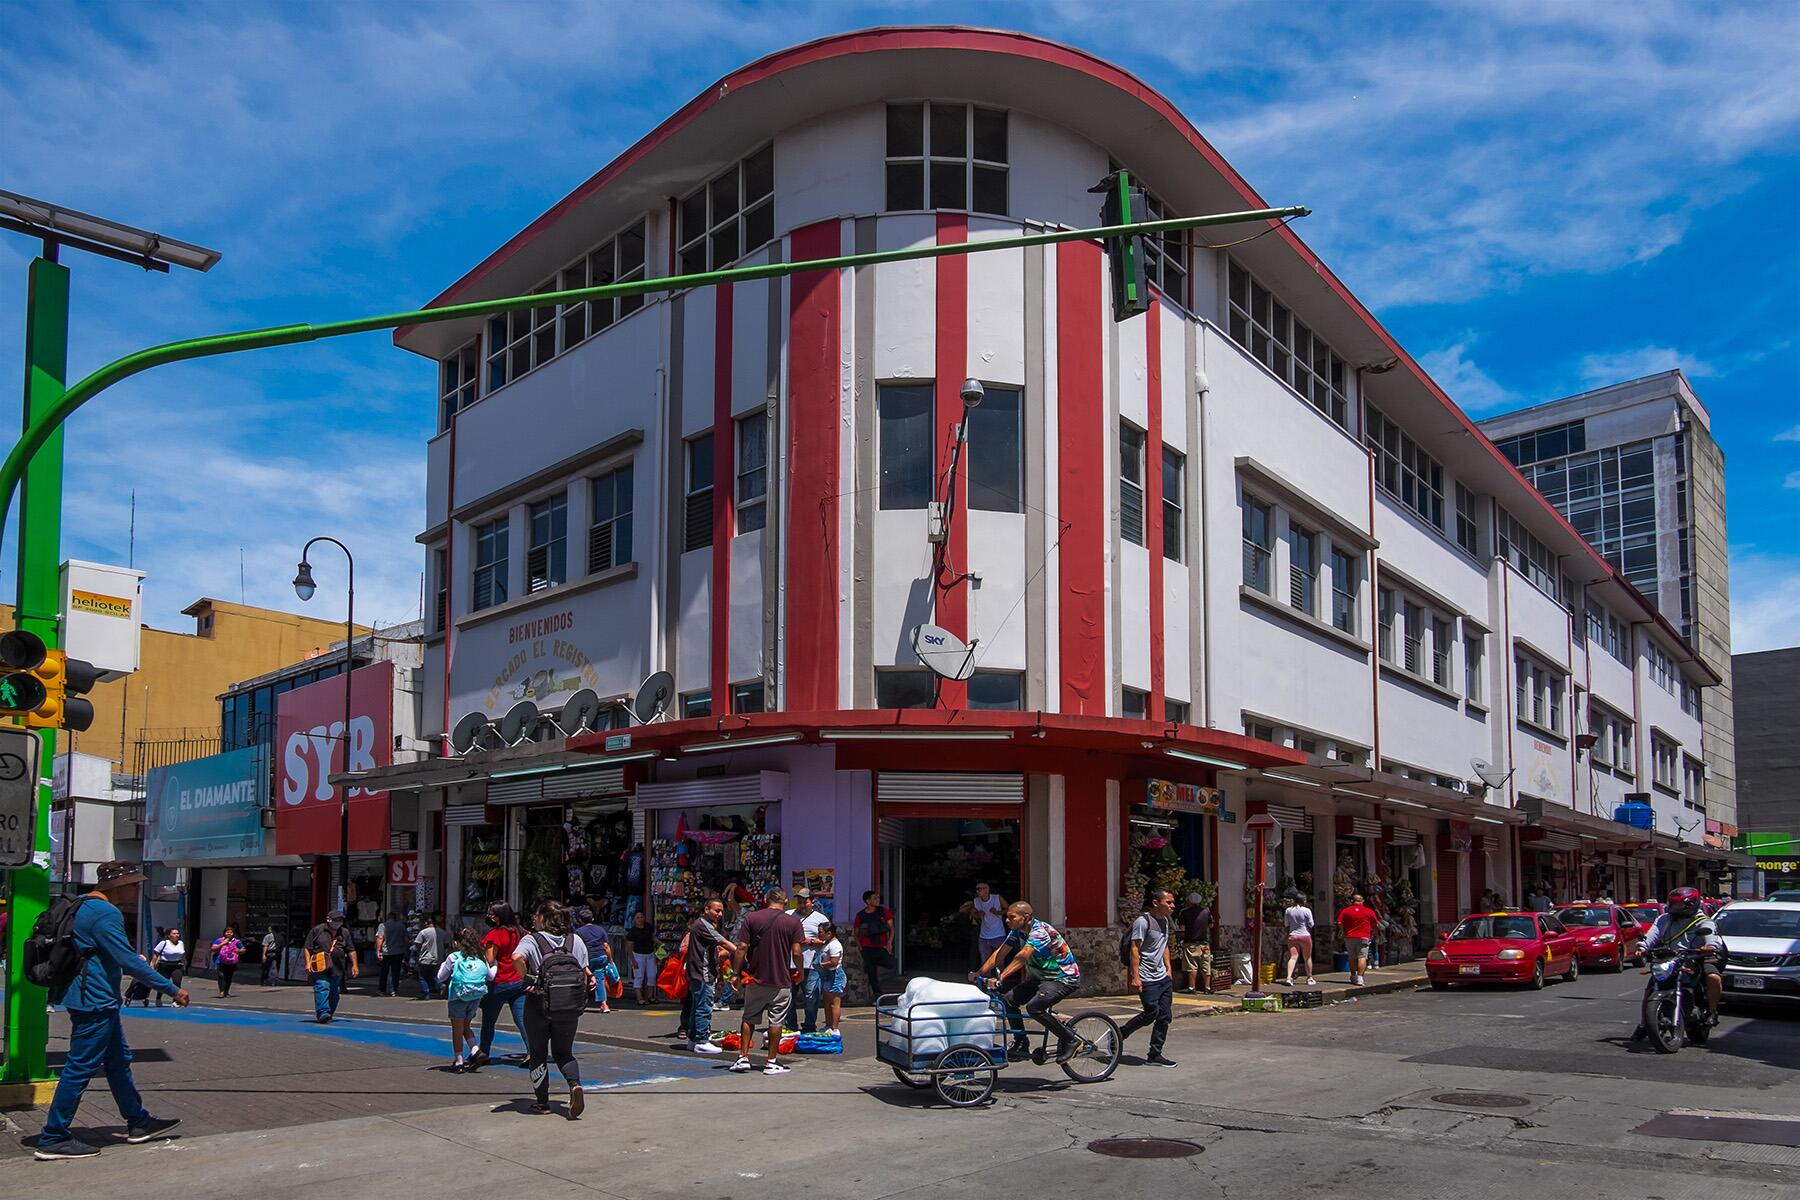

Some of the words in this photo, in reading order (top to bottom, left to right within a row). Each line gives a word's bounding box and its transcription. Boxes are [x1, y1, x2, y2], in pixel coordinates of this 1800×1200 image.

[72, 595, 130, 613] heliotek
[509, 611, 573, 644] BIENVENIDOS
[533, 640, 546, 658] EL
[924, 634, 946, 646] SKY
[180, 789, 193, 811] EL
[194, 779, 256, 809] DIAMANTE
